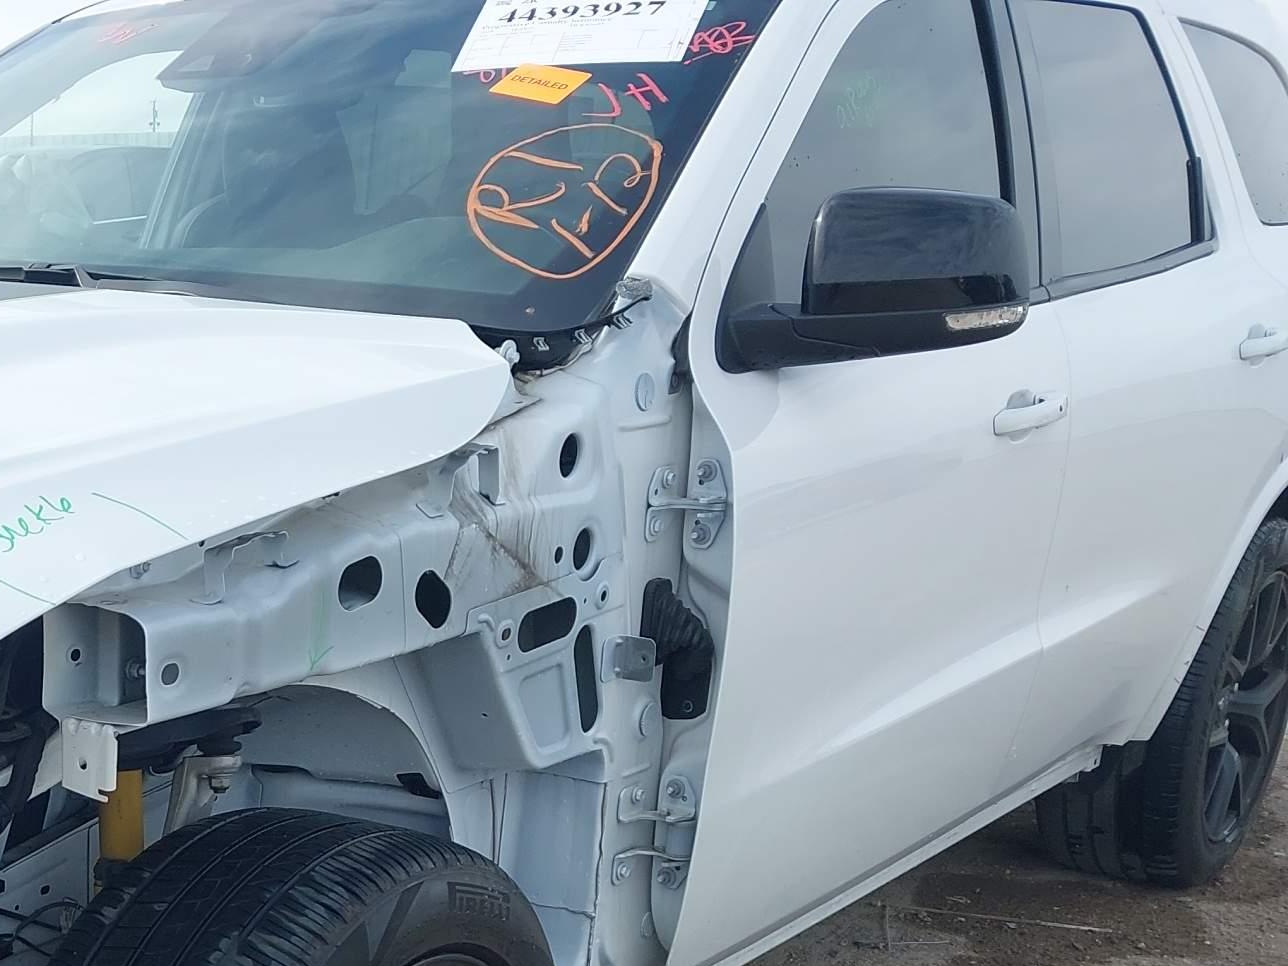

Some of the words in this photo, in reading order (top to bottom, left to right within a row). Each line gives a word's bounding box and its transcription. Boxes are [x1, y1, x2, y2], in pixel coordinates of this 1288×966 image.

[498, 1, 667, 24] 44393927
[509, 74, 570, 91] DETAILED
[447, 881, 510, 920] PIRELLI
